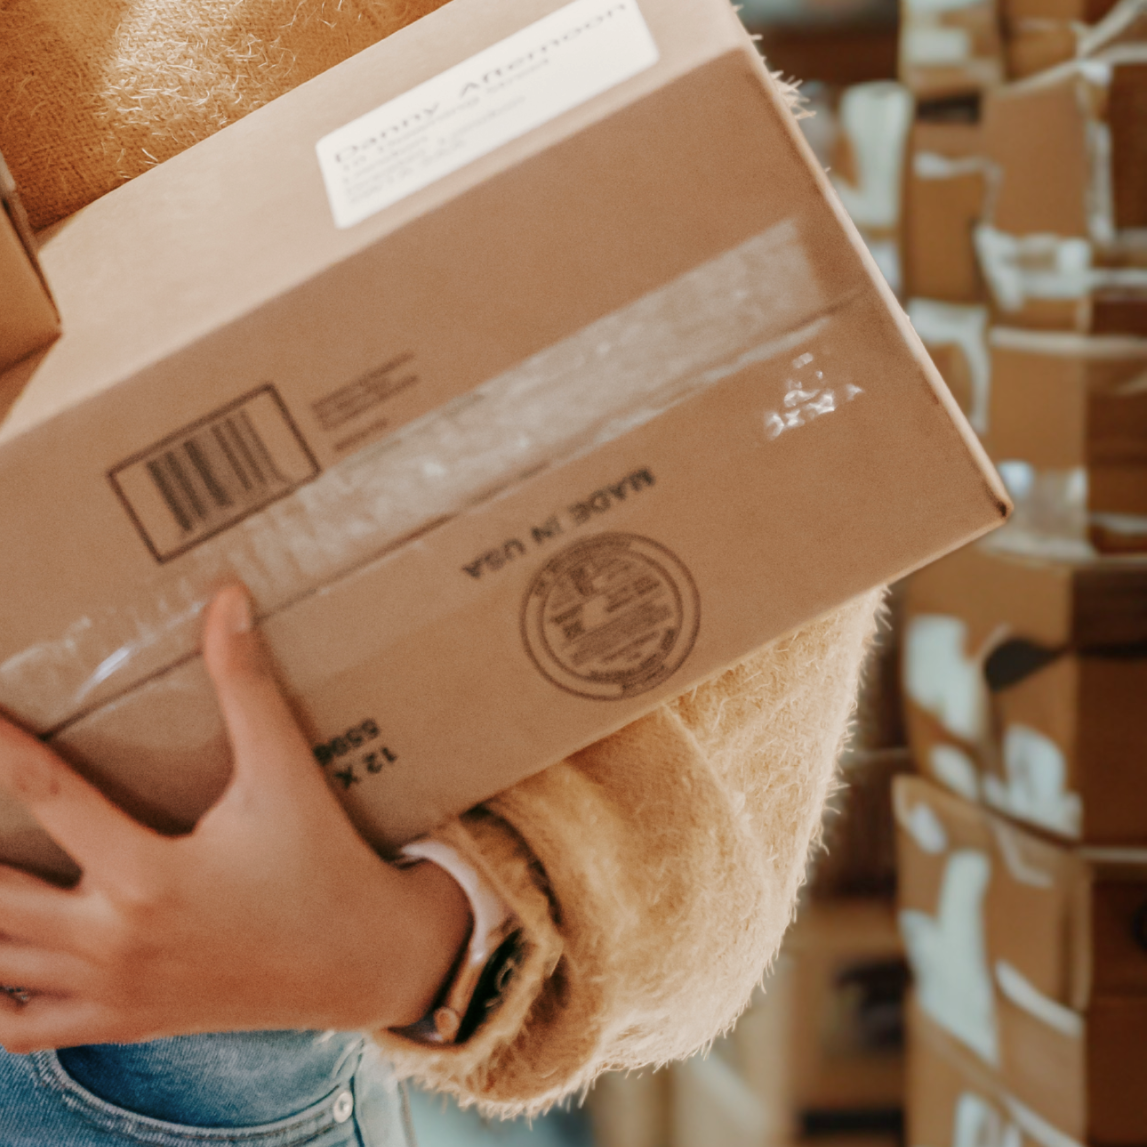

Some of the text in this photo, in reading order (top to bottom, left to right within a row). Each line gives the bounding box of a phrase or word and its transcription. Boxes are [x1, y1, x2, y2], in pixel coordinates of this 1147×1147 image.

[460, 467, 656, 580] MADE IN USA
[363, 747, 397, 773] 12
